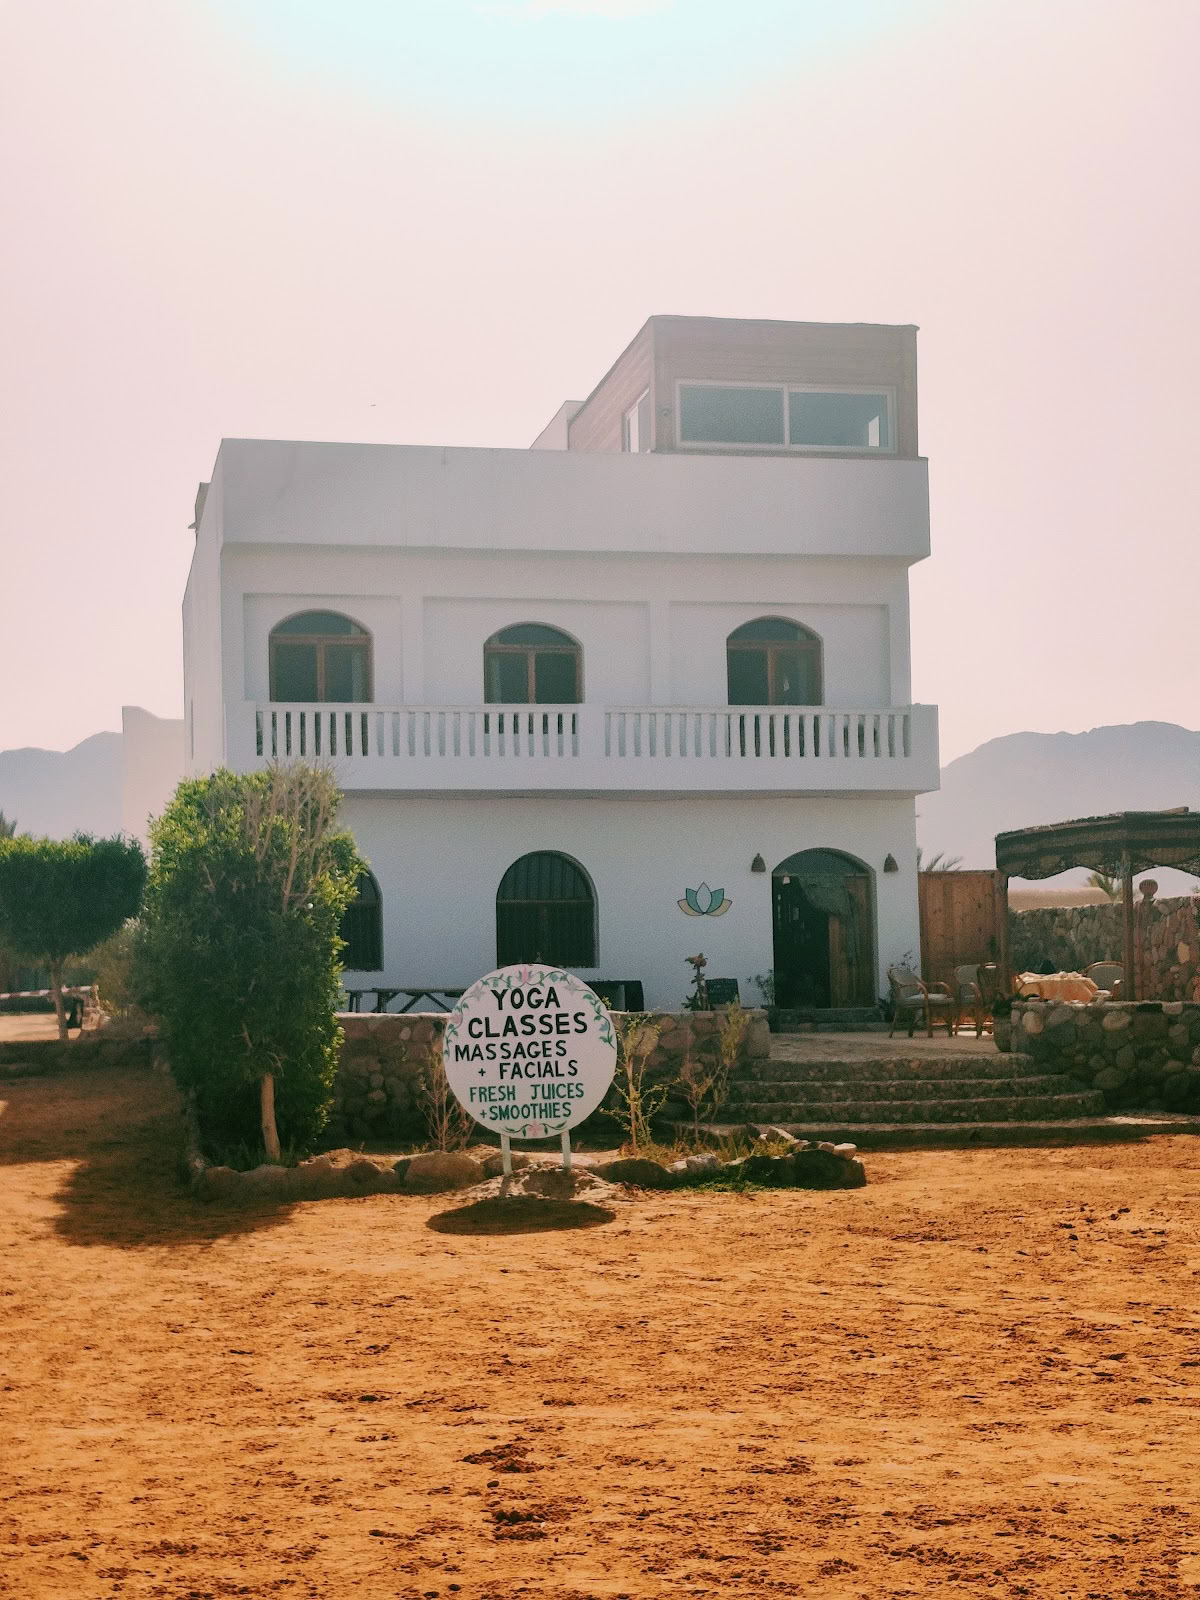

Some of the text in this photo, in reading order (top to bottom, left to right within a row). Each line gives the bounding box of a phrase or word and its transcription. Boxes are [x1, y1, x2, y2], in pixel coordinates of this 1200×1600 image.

[490, 986, 561, 1011] YOGA
[467, 1012, 588, 1039] CLASSES
[454, 1040, 567, 1062] MASSAGES
[499, 1060, 578, 1080] FACIALS
[469, 1082, 584, 1102] FRESH JUICES
